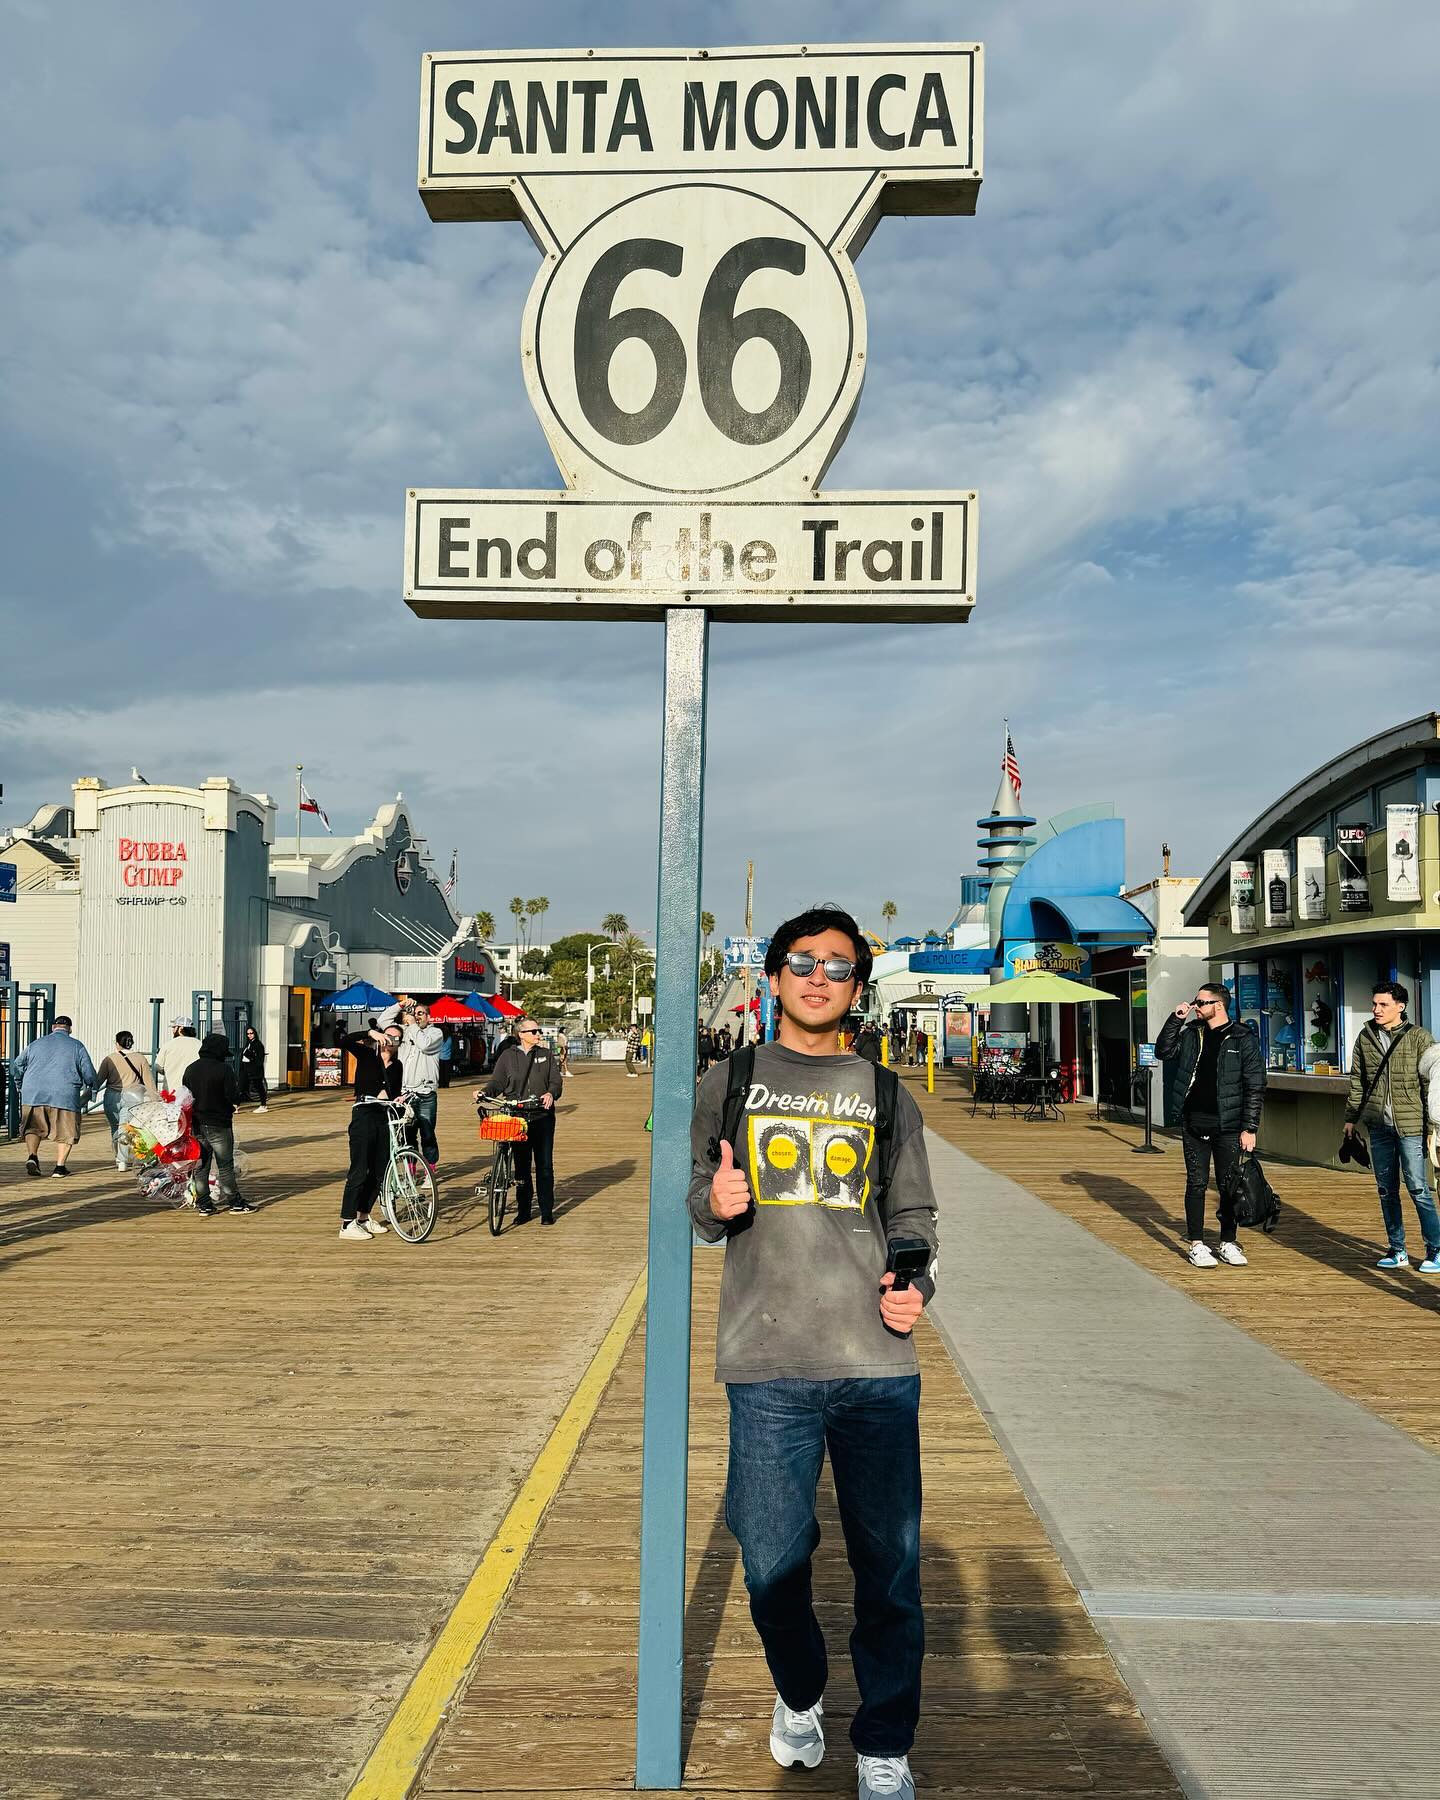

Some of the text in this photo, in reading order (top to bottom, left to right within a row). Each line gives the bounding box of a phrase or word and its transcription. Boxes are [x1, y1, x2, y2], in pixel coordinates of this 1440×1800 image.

[445, 72, 957, 155] SANTA MONICA
[573, 236, 812, 446] 66
[438, 511, 944, 582] End of the Trail
[119, 837, 187, 861] BUBBA
[124, 864, 183, 887] GUMP
[932, 953, 969, 965] POLICE
[1013, 957, 1081, 975] BLAZING SADDLES
[745, 1084, 829, 1115] Dream
[830, 1155, 853, 1163] damage.
